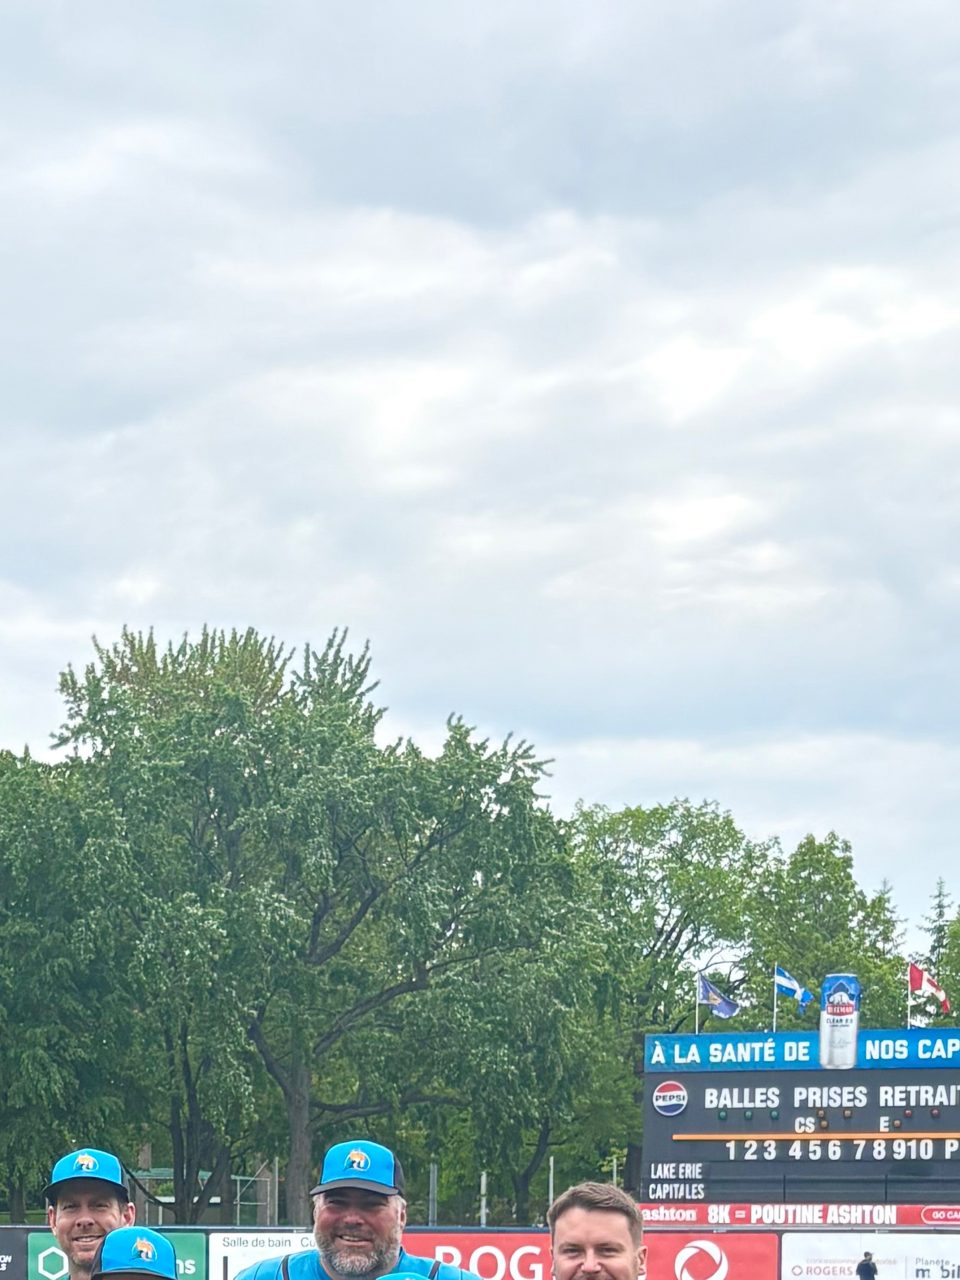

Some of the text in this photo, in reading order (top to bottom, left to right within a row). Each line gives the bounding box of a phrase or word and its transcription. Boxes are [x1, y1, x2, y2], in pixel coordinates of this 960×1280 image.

[651, 1041, 666, 1064] À
[674, 1043, 701, 1064] LA
[709, 1038, 776, 1063] SANTÉ
[784, 1041, 811, 1062] DE
[865, 1039, 909, 1060] NOS
[918, 1038, 960, 1059] CAP
[655, 1094, 686, 1102] PEPSI
[704, 1085, 960, 1109] BALLES PRISES RETRAI
[794, 1116, 890, 1134] CS E
[725, 1140, 736, 1160] 1
[744, 1140, 758, 1160] 2
[763, 1140, 777, 1160] 3
[788, 1140, 802, 1160] 4
[808, 1140, 822, 1160] 5
[828, 1140, 842, 1160] 6
[853, 1140, 866, 1160] 7
[872, 1139, 887, 1160] 8
[944, 1139, 959, 1160] P
[650, 1163, 703, 1179] LAKE ERIE
[648, 1183, 705, 1200] CAPITALES
[642, 1206, 697, 1222] ashton
[707, 1204, 730, 1224] 8K
[750, 1204, 824, 1224] POUTINE
[826, 1204, 897, 1224] ASHTON
[931, 1211, 960, 1219] GO CA
[222, 1237, 249, 1248] Salle
[251, 1237, 266, 1248] de
[267, 1237, 292, 1248] bain
[915, 1257, 951, 1266] Planète
[805, 1265, 854, 1276] ROGERS
[915, 1264, 960, 1279] mbil
